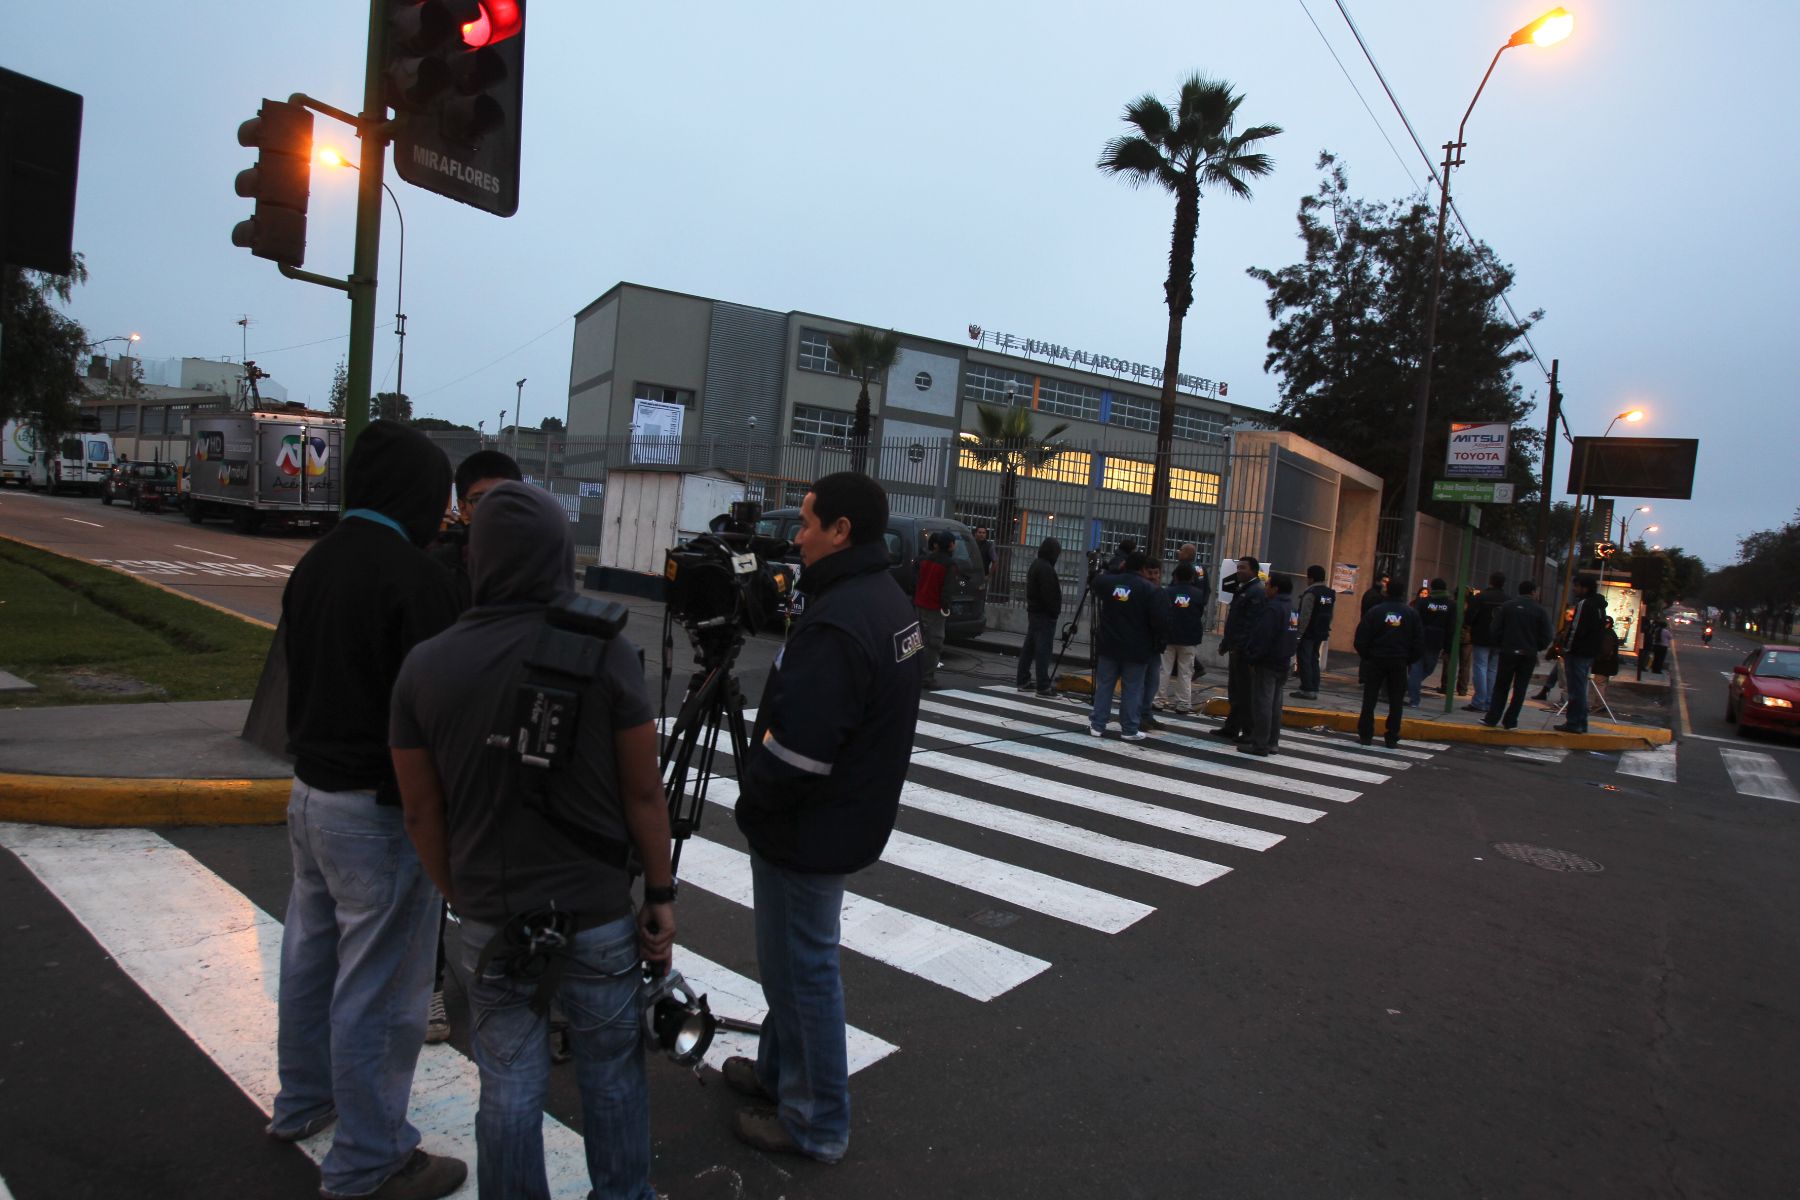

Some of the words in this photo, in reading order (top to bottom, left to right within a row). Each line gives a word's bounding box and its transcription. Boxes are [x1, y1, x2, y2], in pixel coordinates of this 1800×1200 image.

[412, 143, 500, 194] MIRAFLORES
[1021, 338, 1070, 361] JUANA
[1072, 349, 1130, 373] ALARCO
[1131, 362, 1150, 378] DE
[210, 435, 222, 452] HD
[1453, 434, 1504, 443] MITSUI
[275, 443, 329, 468] ATV
[1454, 452, 1500, 461] TOYOTA
[1112, 587, 1131, 597] ATV
[1174, 596, 1191, 604] ATV
[1384, 614, 1402, 623] ATV
